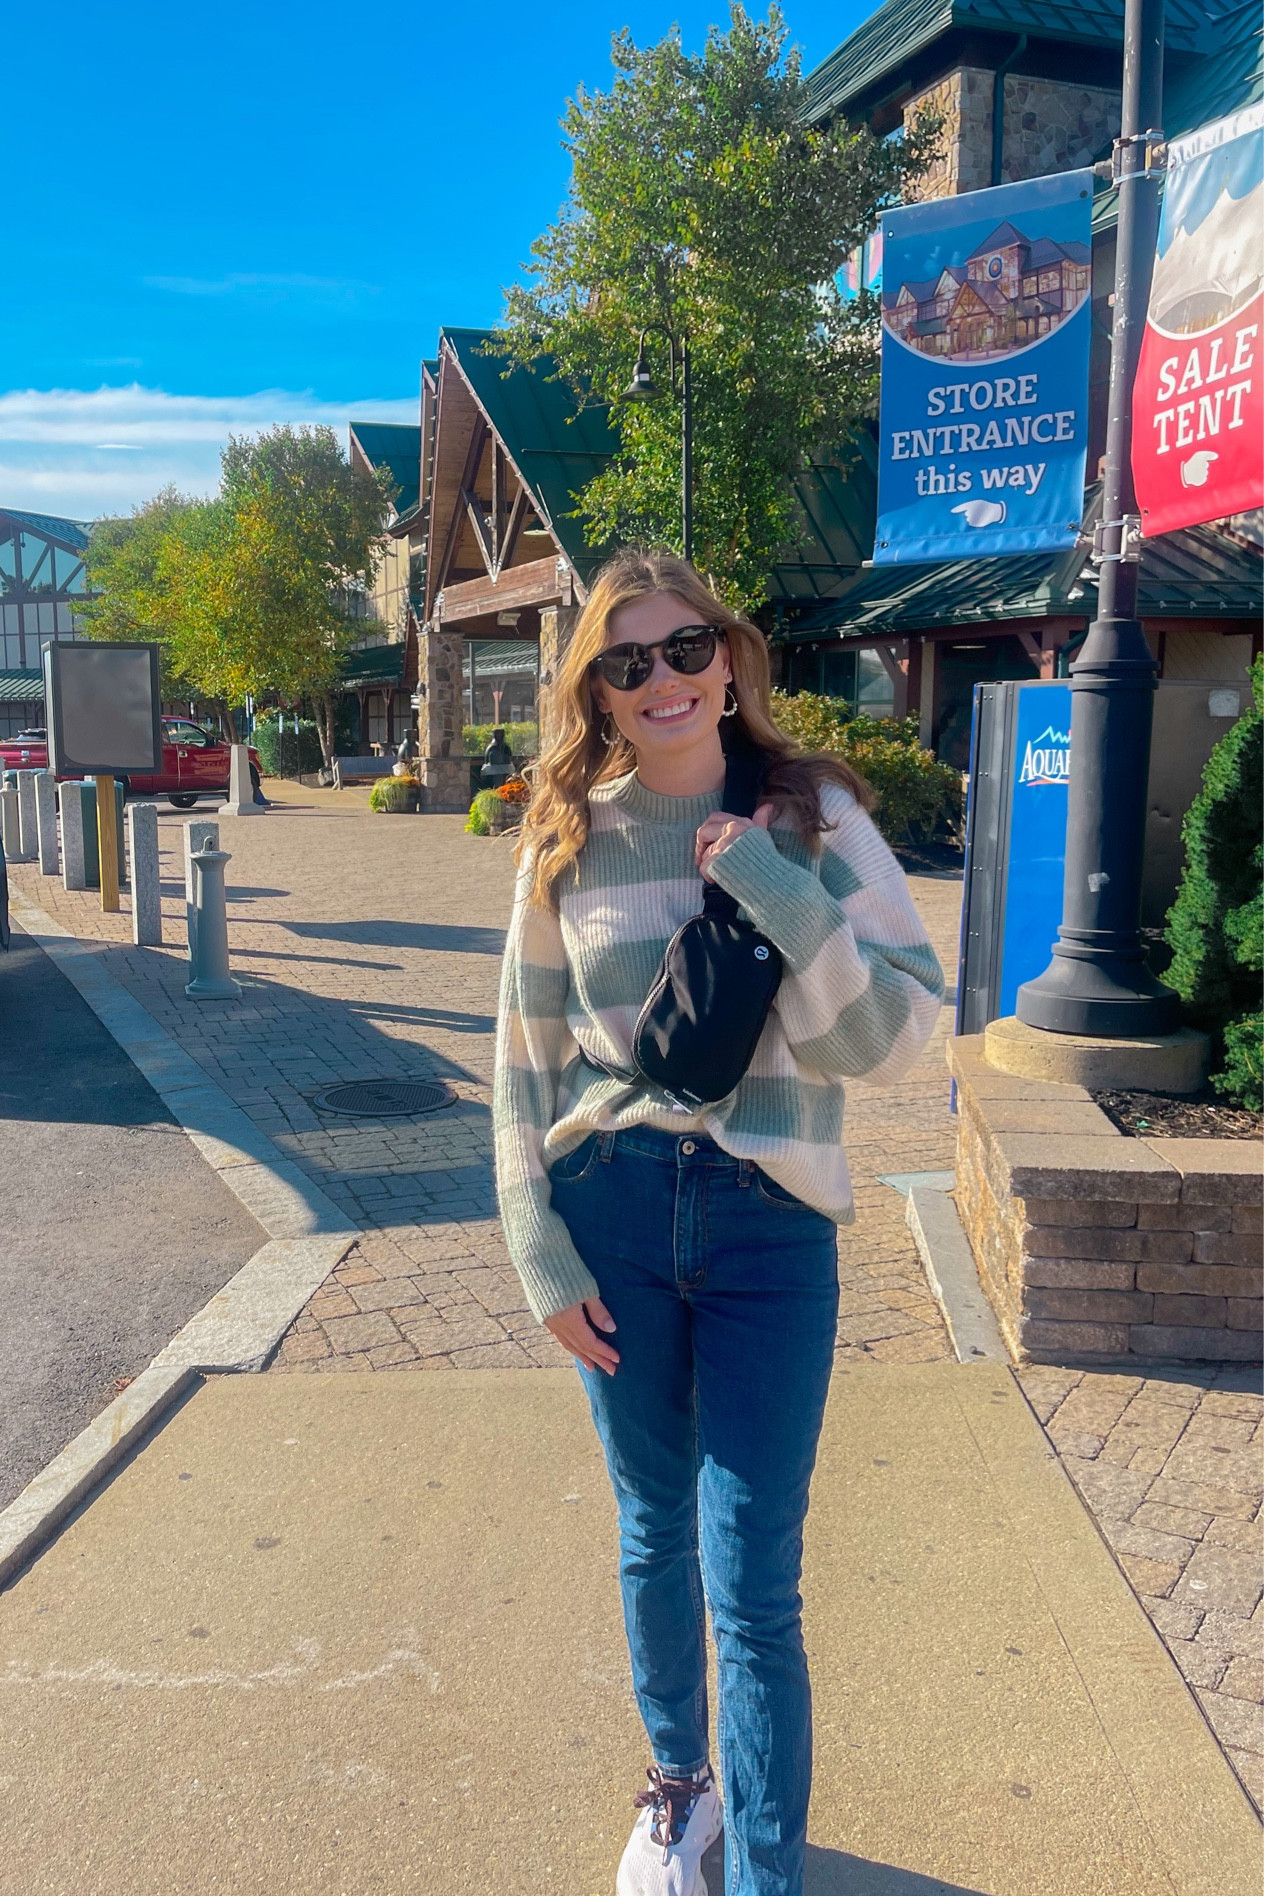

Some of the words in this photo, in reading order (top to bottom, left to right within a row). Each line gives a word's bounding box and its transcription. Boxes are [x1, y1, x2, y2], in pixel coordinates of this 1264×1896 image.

[1156, 323, 1258, 402] SALE
[927, 374, 1038, 416] STORE
[1153, 379, 1251, 455] TENT
[891, 410, 1075, 460] ENTRANCE
[915, 463, 972, 496] this
[980, 462, 1046, 495] way
